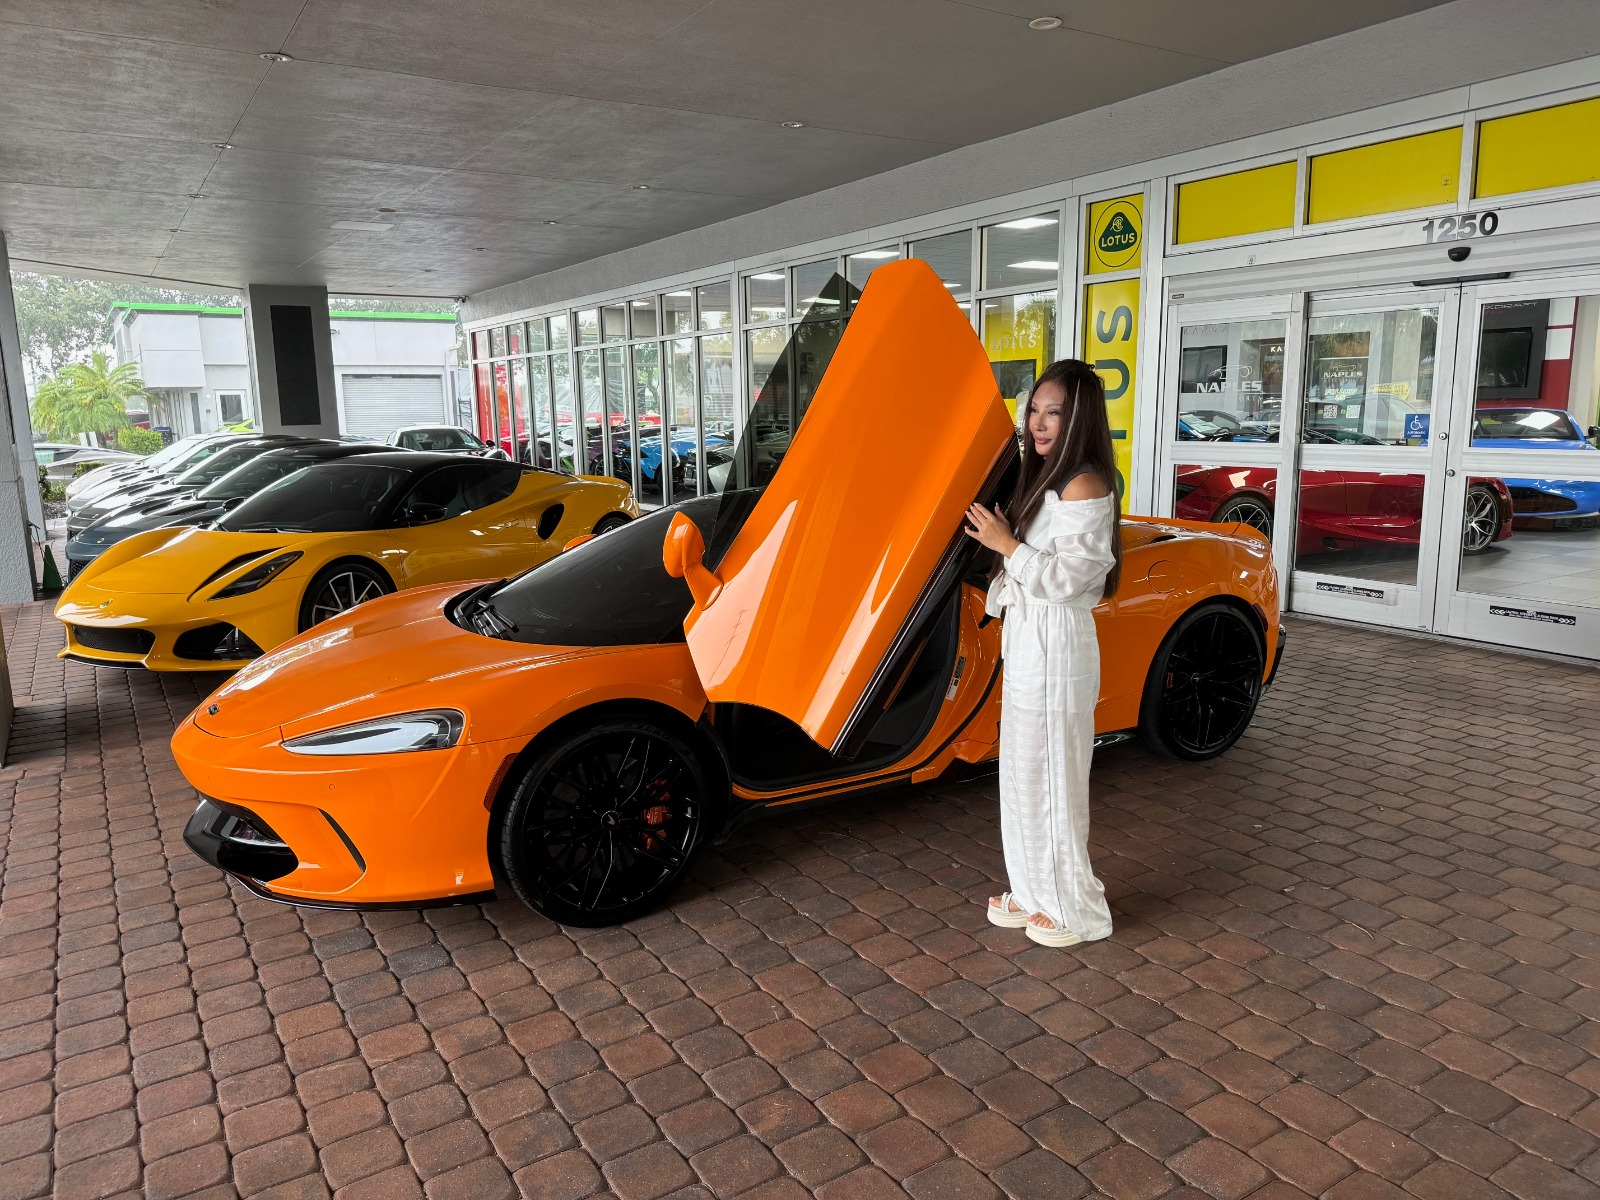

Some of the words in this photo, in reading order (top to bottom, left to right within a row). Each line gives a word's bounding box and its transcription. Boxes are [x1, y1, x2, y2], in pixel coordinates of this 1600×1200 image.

[1422, 212, 1499, 244] 1250
[1101, 233, 1135, 247] LOTUS
[992, 333, 1037, 350] LOTUS
[1323, 370, 1363, 378] NAPLES
[1196, 380, 1262, 393] NAPLES
